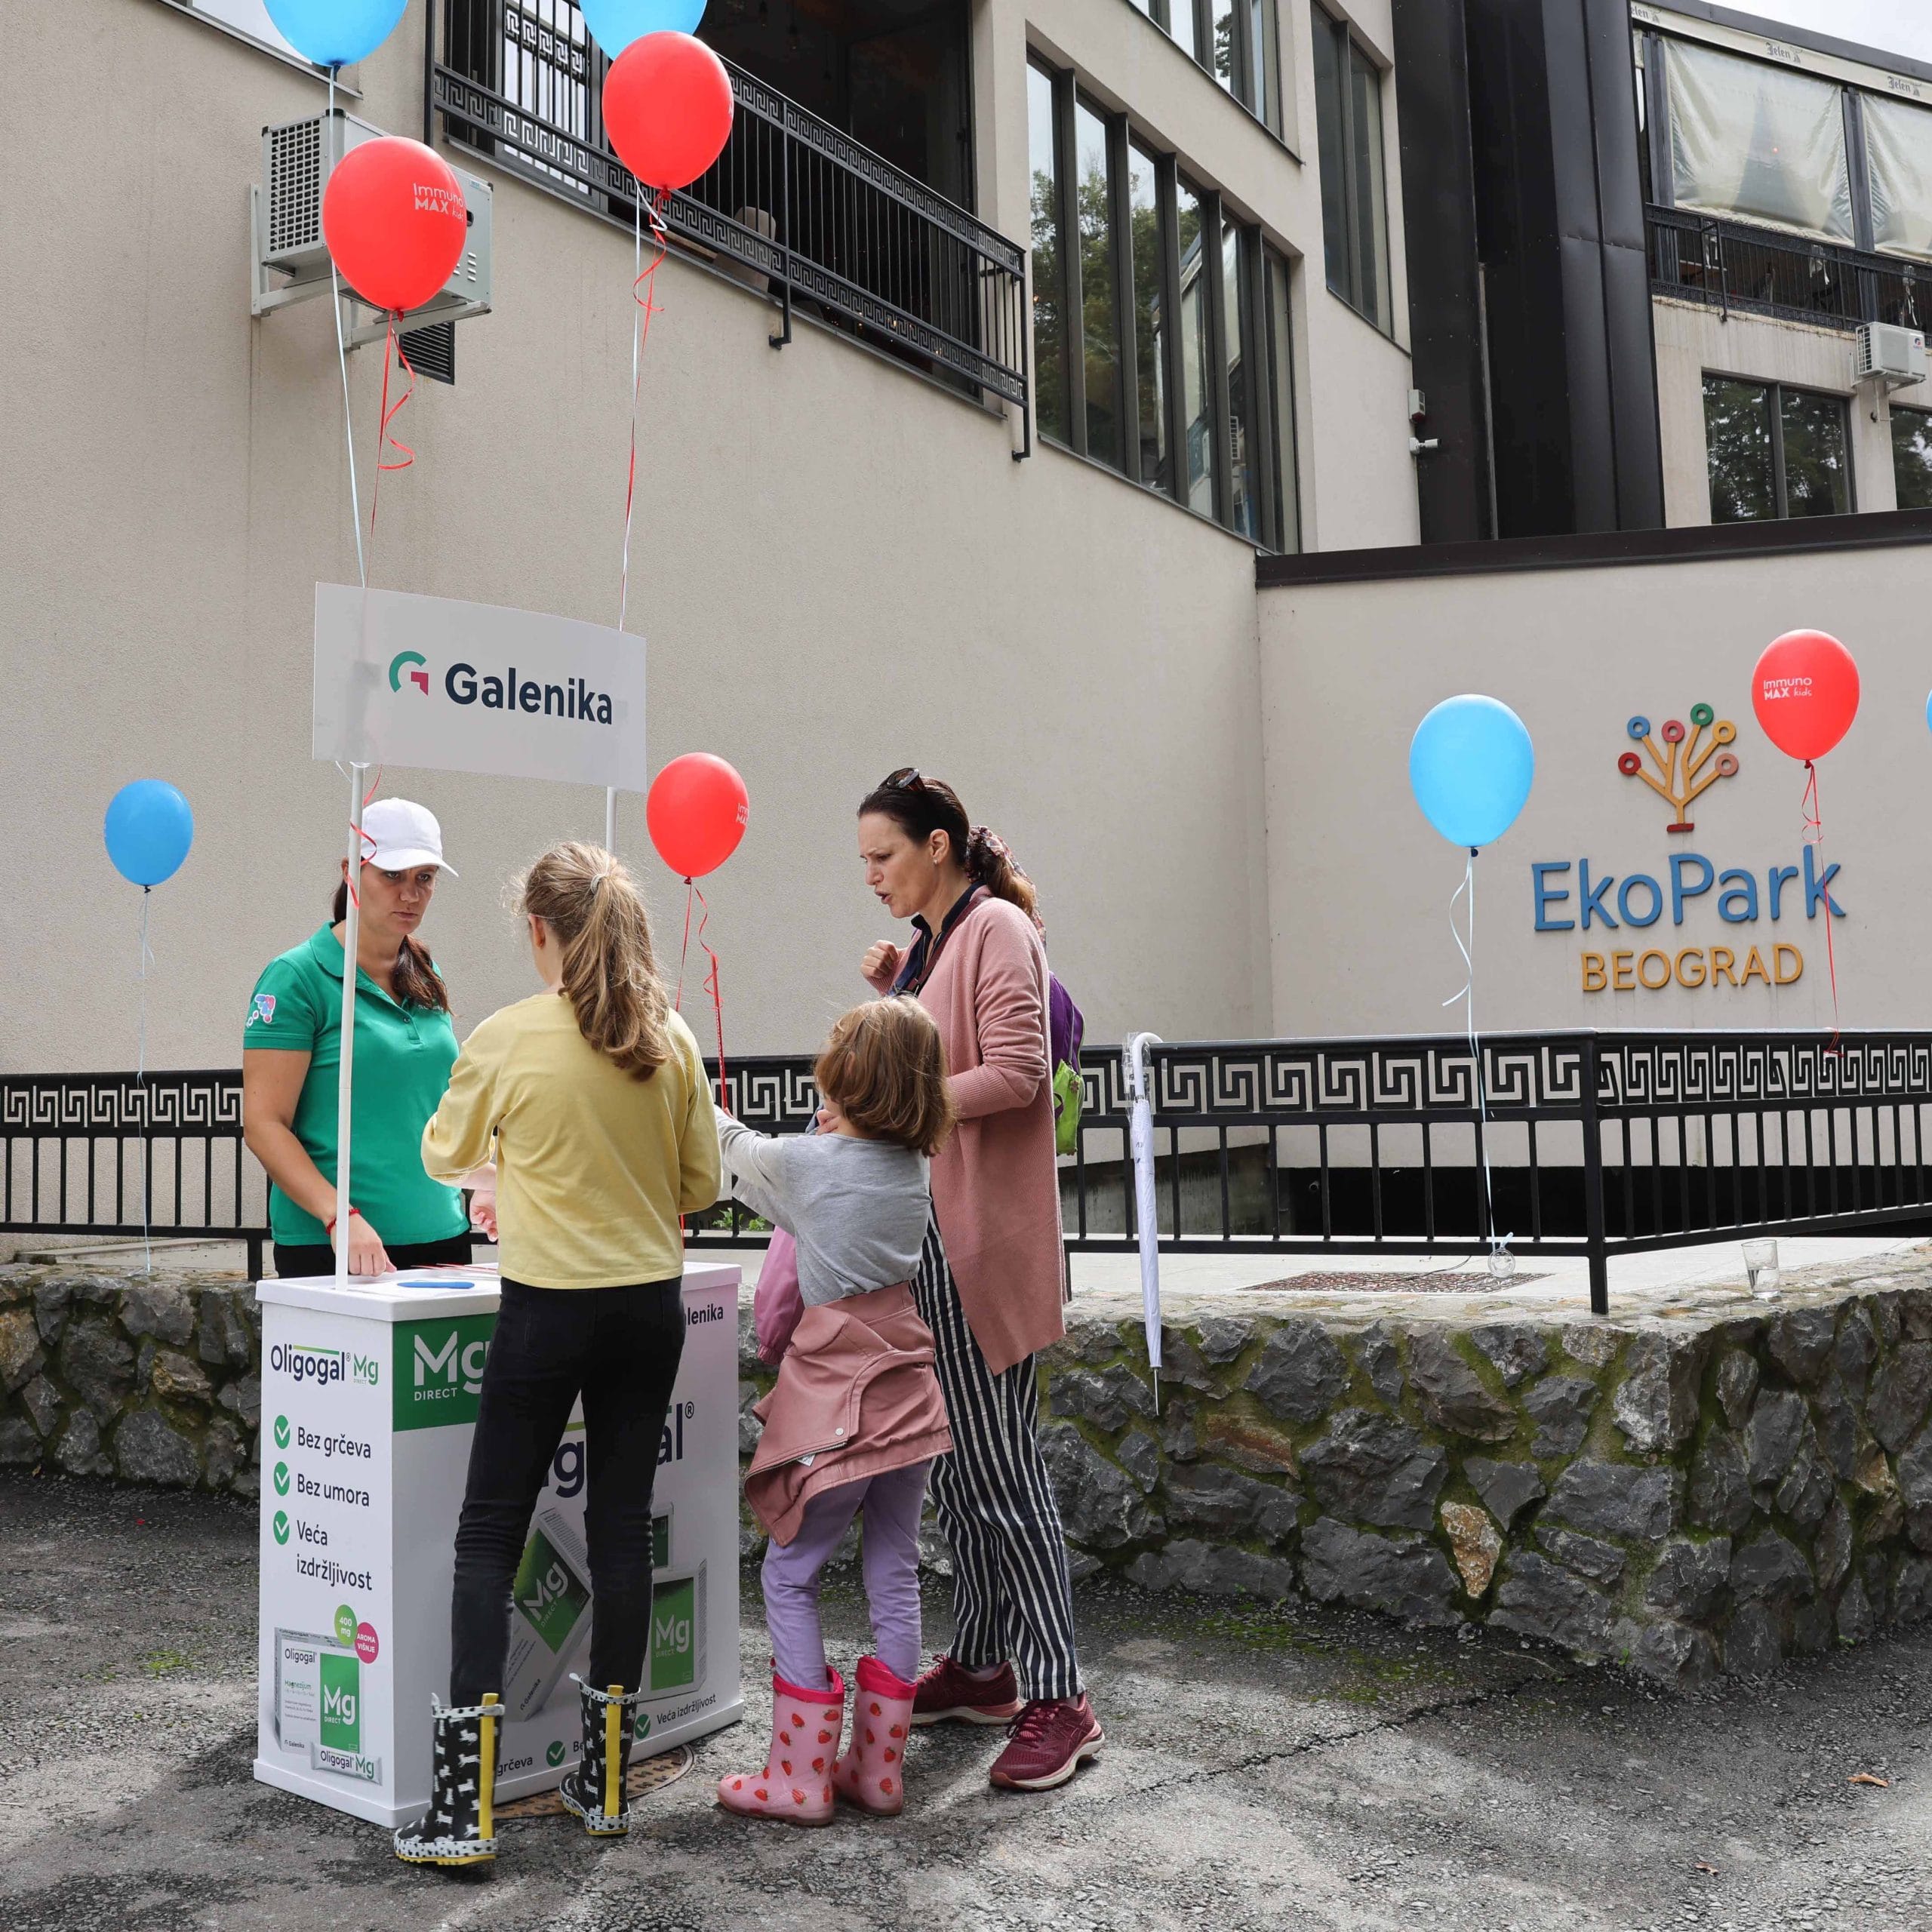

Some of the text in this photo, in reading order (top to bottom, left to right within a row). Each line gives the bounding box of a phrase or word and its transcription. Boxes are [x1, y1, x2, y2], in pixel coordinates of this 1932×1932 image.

[1631, 6, 1649, 20] elen
[414, 197, 449, 215] MAX
[445, 663, 613, 725] Galenika
[1764, 688, 1790, 700] MAX
[1531, 844, 1847, 931] EkoPark
[1580, 943, 1804, 991] BEOGRAD
[685, 1303, 724, 1325] lenika
[353, 1352, 379, 1386] Mg
[414, 1331, 491, 1394] Mg
[414, 1388, 457, 1401] DIRECT
[297, 1426, 371, 1459] Bez grčeva
[297, 1473, 370, 1507] Bez umora
[297, 1519, 328, 1546] Veća
[297, 1553, 373, 1591] izdržljivost
[523, 1561, 569, 1622] Mg
[339, 1617, 352, 1627] 400
[340, 1627, 351, 1637] mg
[655, 1614, 690, 1653] Mg
[357, 1632, 376, 1644] AROMA
[357, 1641, 376, 1654] VIŠNJE
[324, 1684, 356, 1725] Mg
[657, 1694, 716, 1724] Veća izdržljivost
[324, 1716, 341, 1724] DIRECT
[355, 1755, 374, 1780] Mg
[497, 1756, 533, 1777] grčeva
